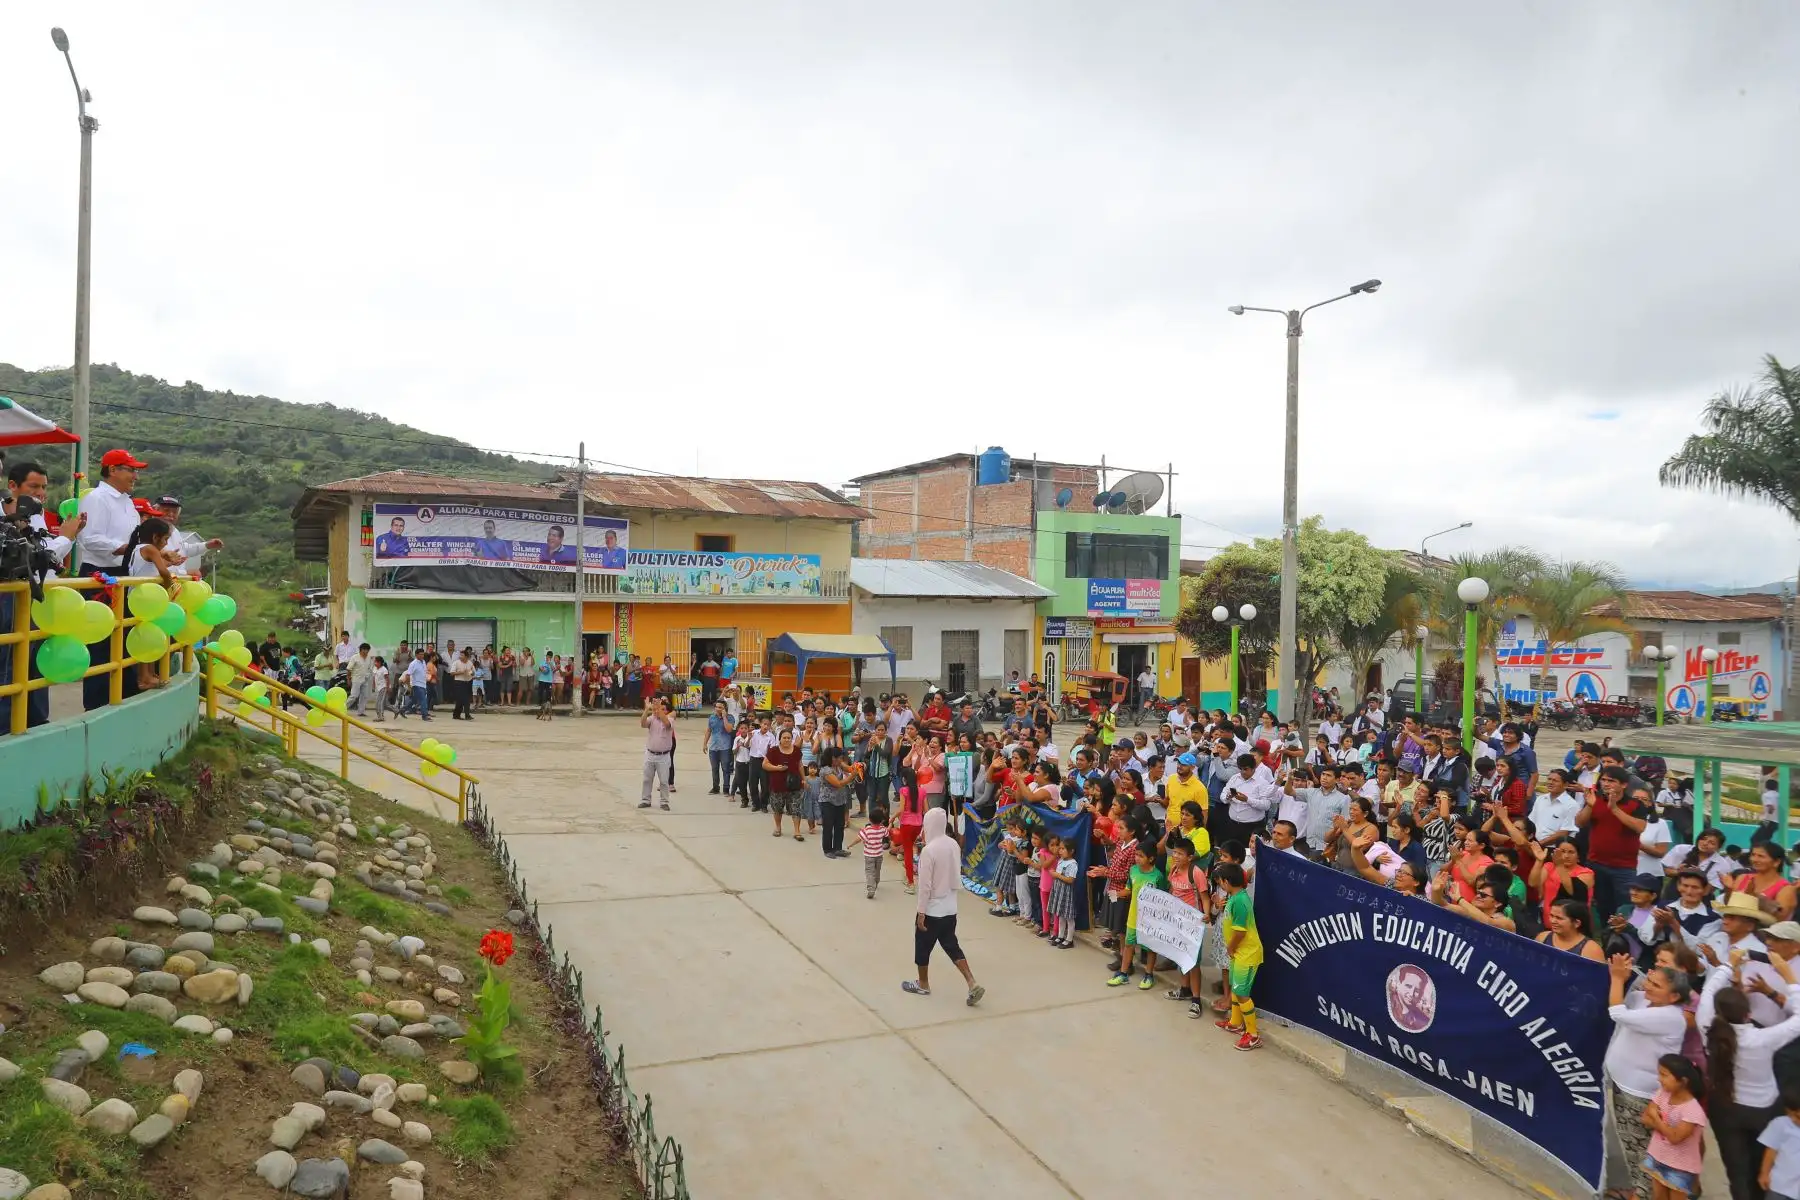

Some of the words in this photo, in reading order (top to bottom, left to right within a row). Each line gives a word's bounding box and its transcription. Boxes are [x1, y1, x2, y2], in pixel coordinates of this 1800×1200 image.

[438, 506, 481, 515] ALIANZA
[482, 509, 506, 518] PARA
[508, 511, 520, 519] EL
[521, 512, 575, 523] PROGRESO
[627, 552, 724, 567] MULTIVENTAS
[1275, 911, 1364, 969] INSTITUCION
[1372, 912, 1475, 975] EDUCATIVA
[1476, 960, 1530, 1018] CIRO
[1519, 1016, 1601, 1110] ALEGRIA
[1317, 994, 1384, 1047] SANTA
